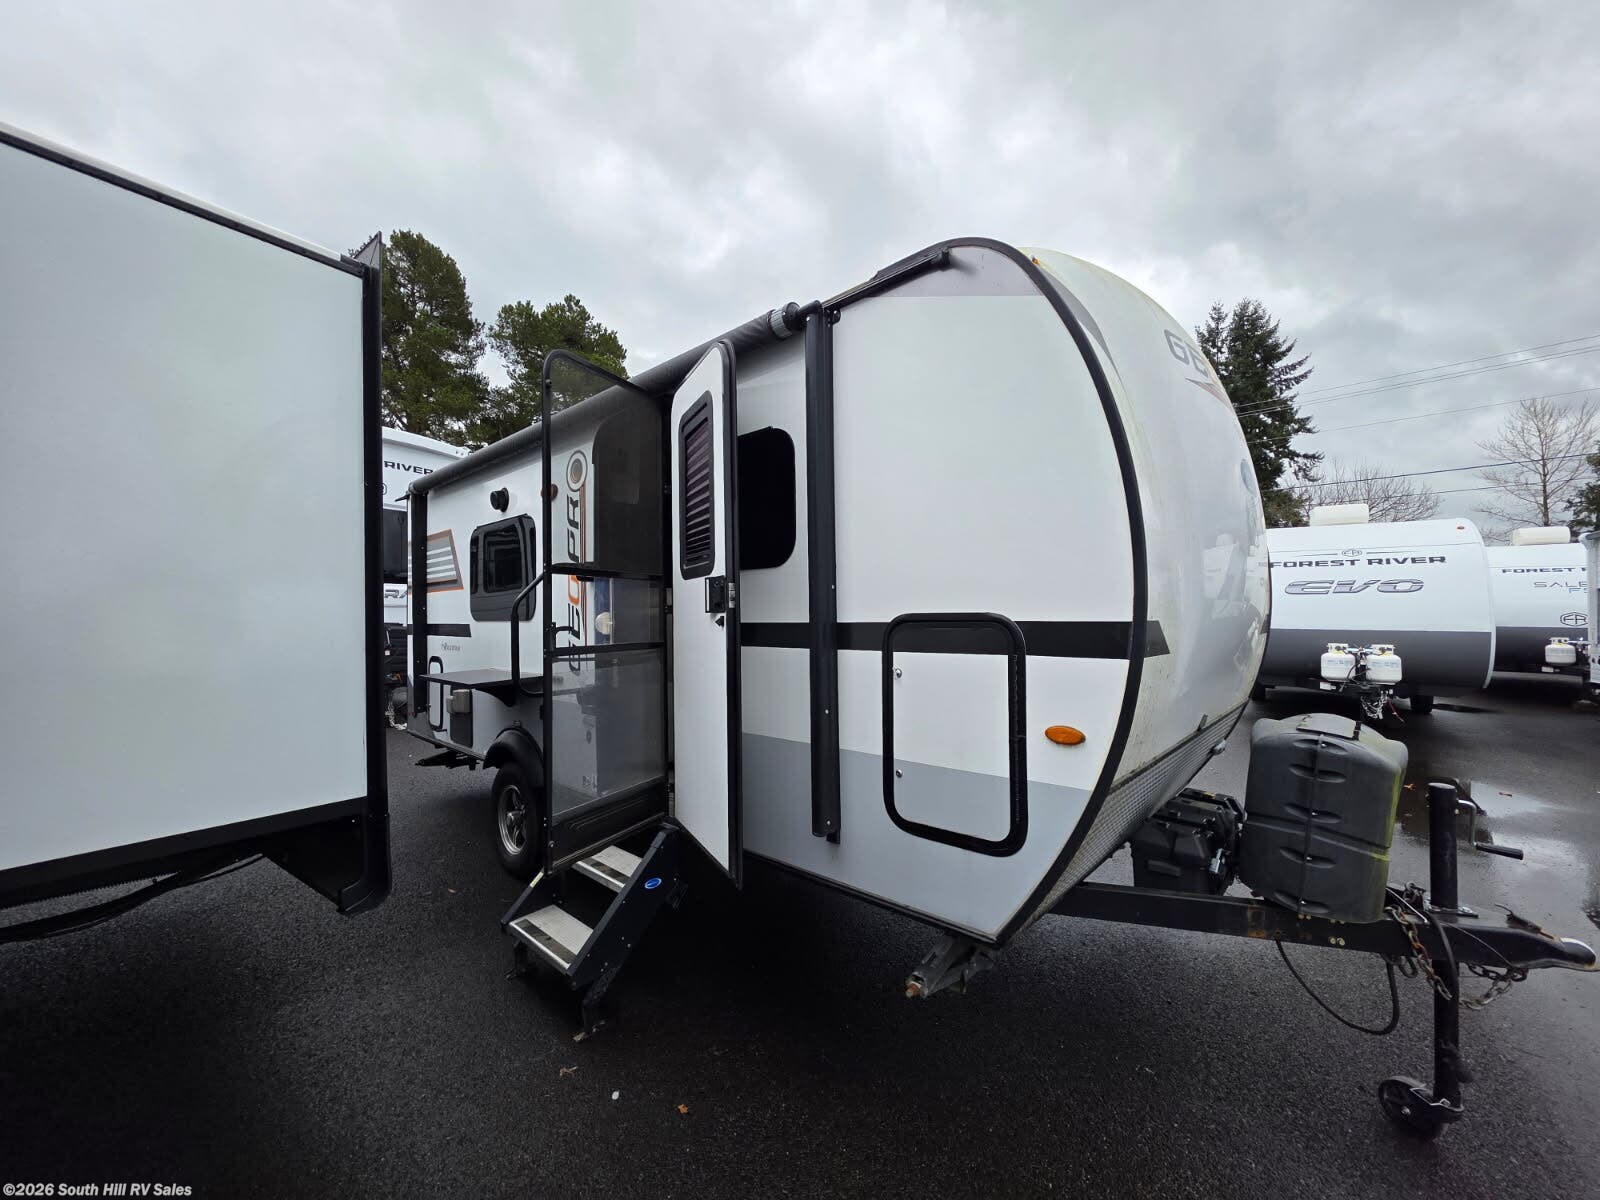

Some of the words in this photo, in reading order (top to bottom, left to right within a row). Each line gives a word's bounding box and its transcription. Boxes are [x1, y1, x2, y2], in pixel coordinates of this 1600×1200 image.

[383, 460, 434, 475] RIVER
[1270, 559, 1360, 569] FOREST
[1367, 556, 1447, 566] RIVER
[1285, 579, 1425, 595] EVO
